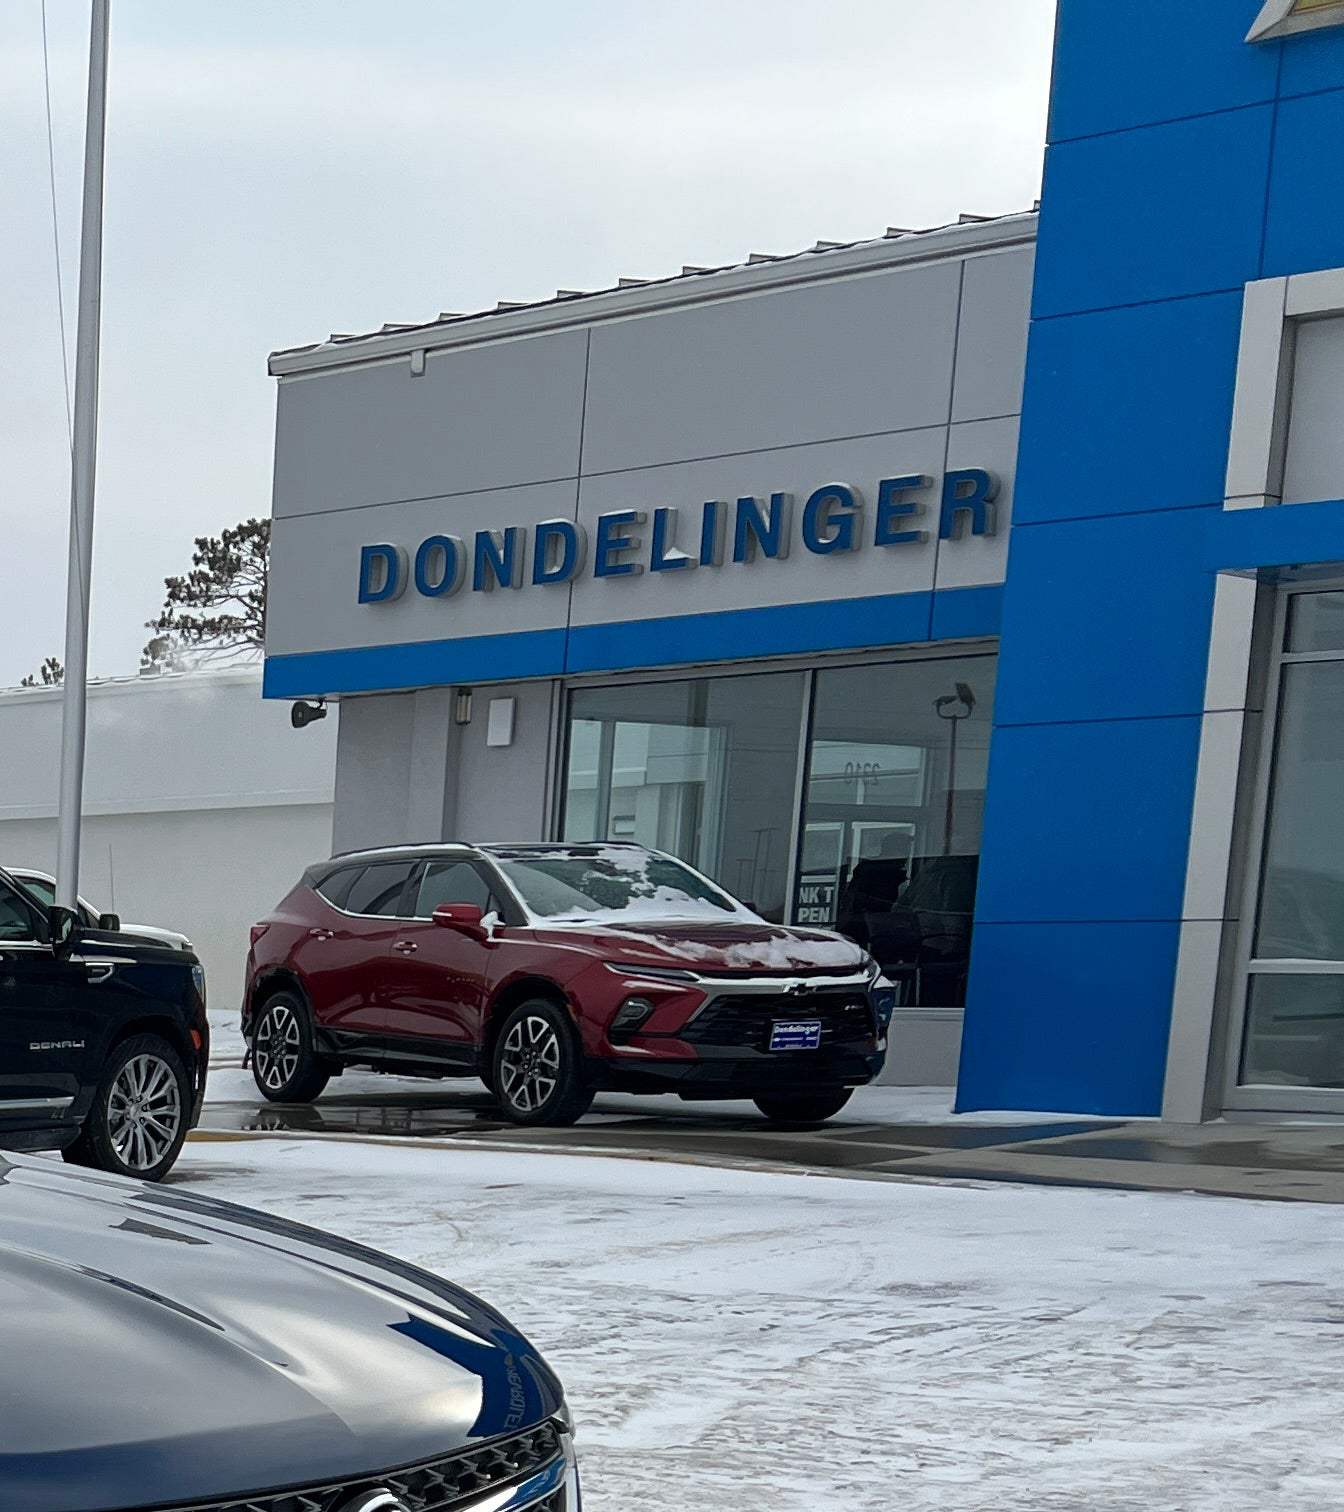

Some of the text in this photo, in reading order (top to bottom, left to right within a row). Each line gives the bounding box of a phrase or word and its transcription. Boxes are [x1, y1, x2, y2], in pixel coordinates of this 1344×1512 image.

[356, 466, 1002, 606] DONDELINGER
[774, 1025, 820, 1035] Dondelinger
[29, 1039, 85, 1050] DENALI
